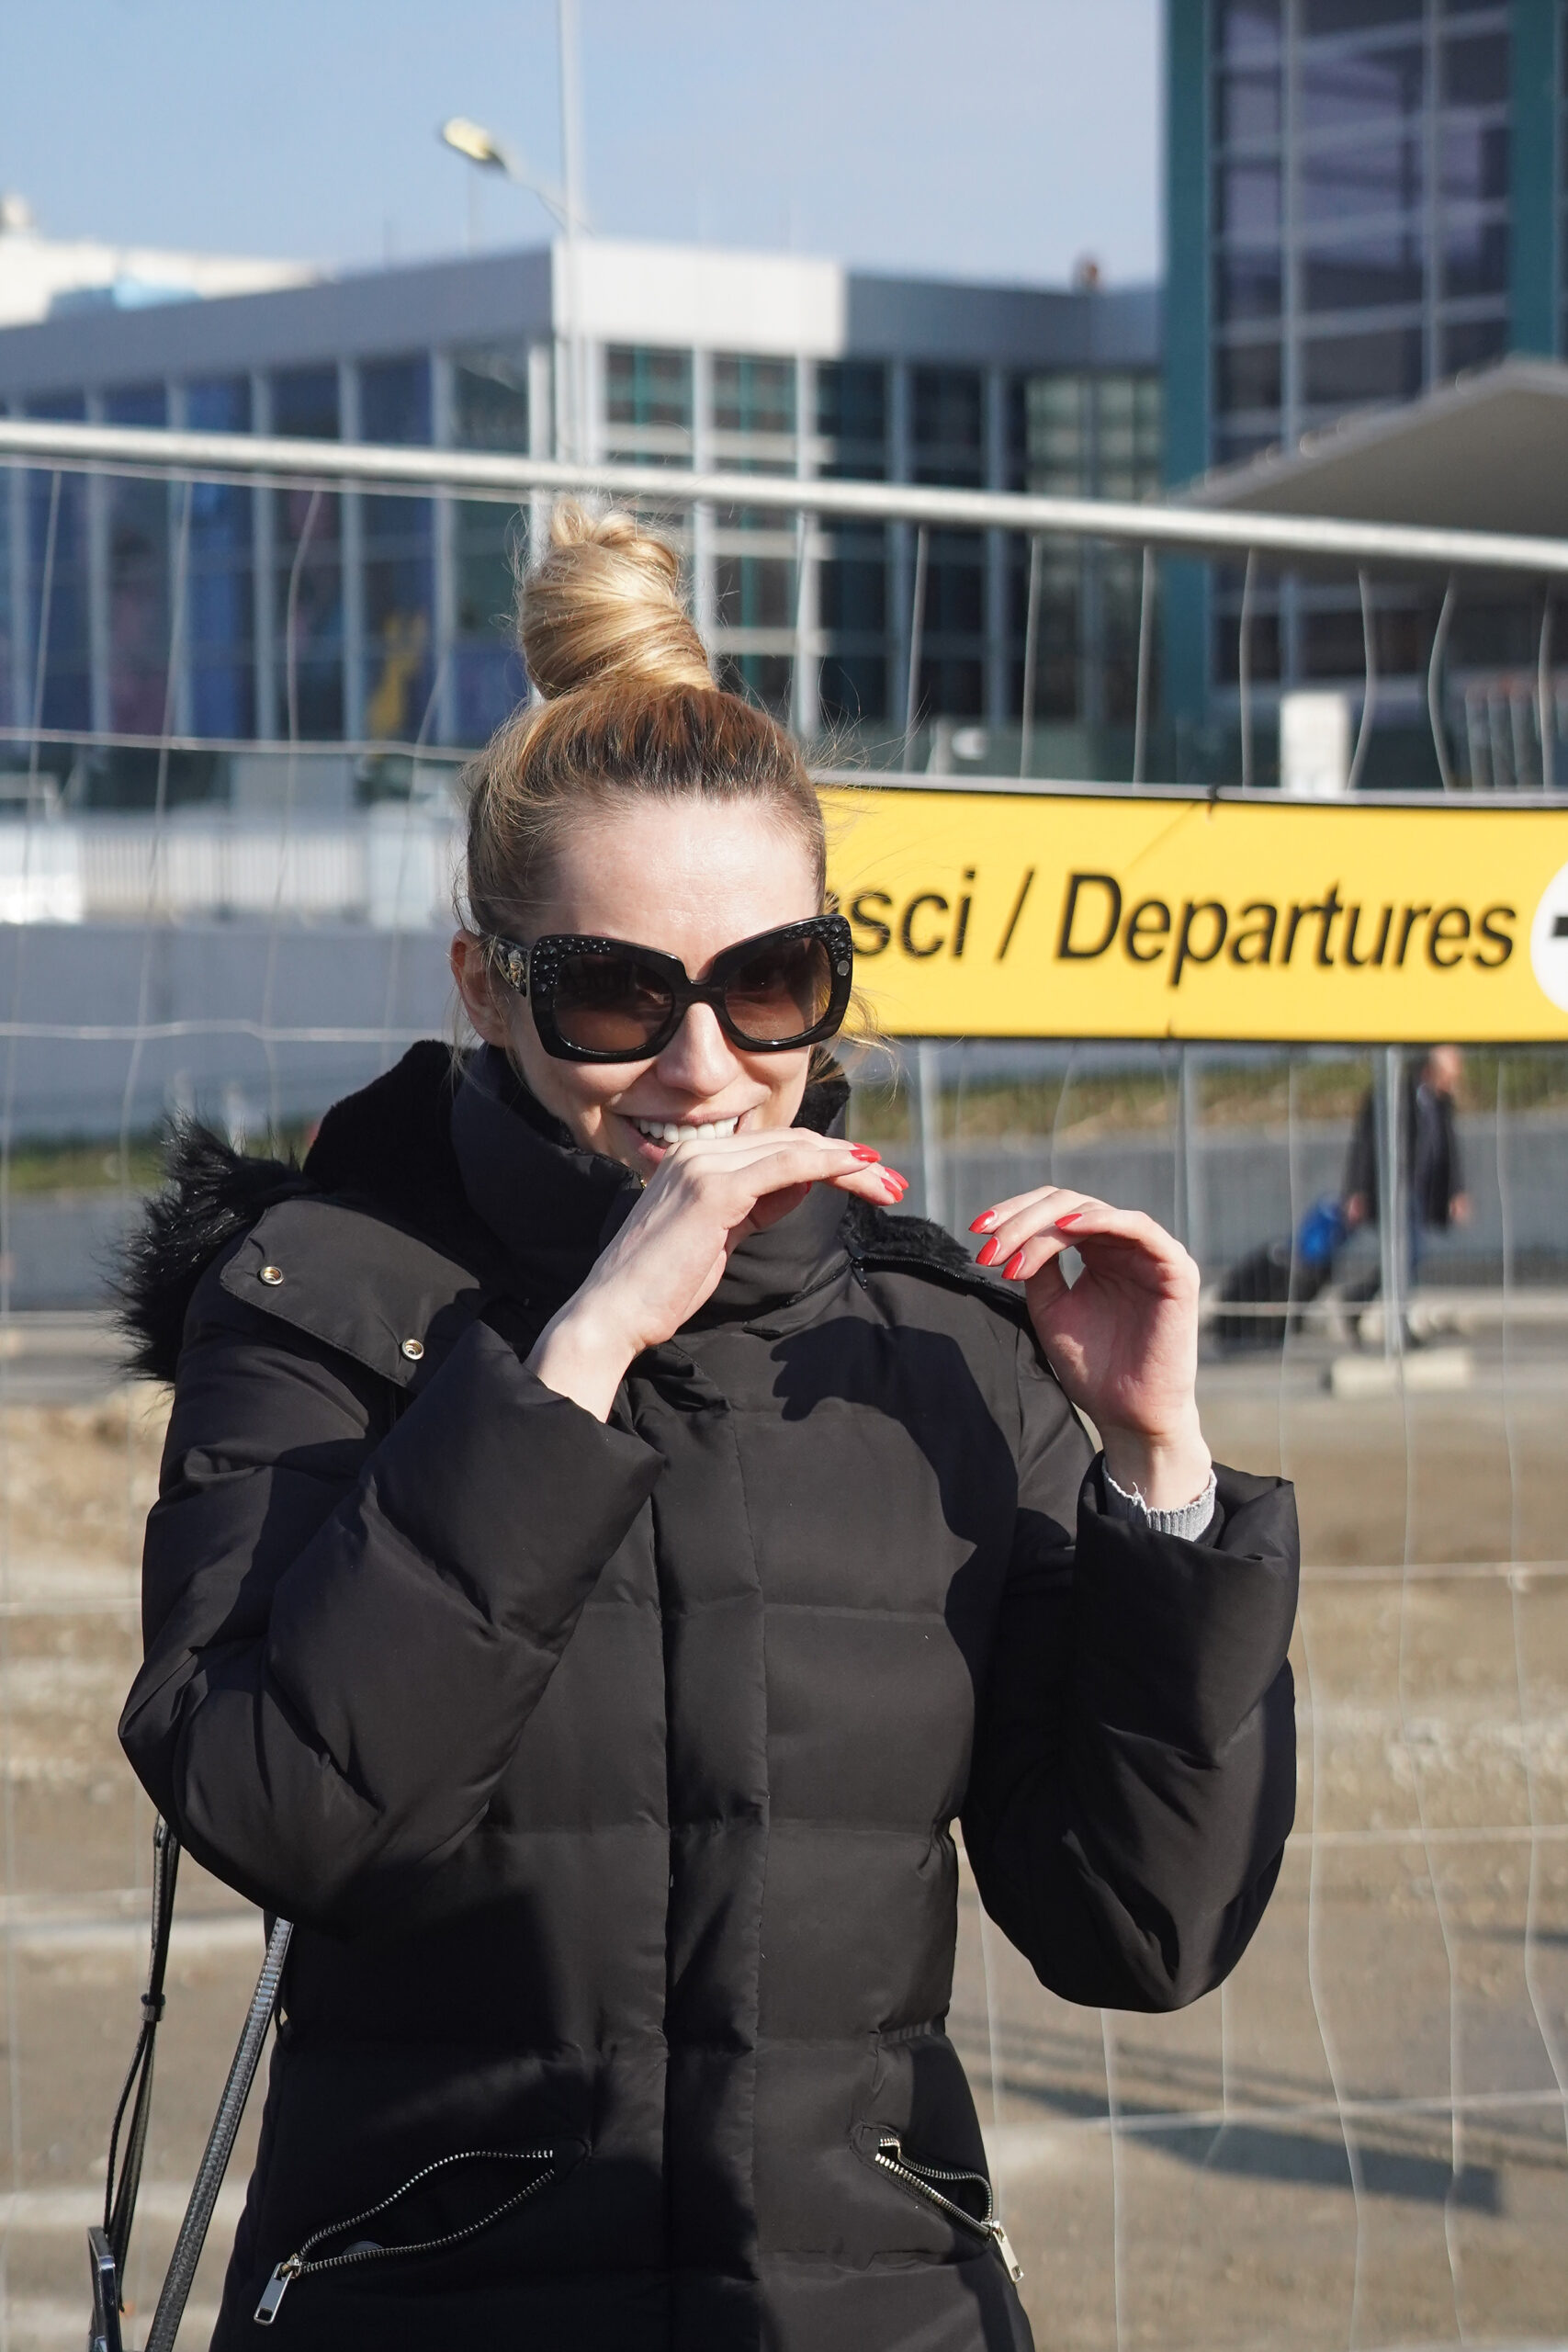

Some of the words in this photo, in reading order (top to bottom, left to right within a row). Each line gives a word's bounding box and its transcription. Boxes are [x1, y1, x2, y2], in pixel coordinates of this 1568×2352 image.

[827, 866, 976, 959] sci
[998, 865, 1035, 960] /
[1056, 872, 1517, 988] Departures
